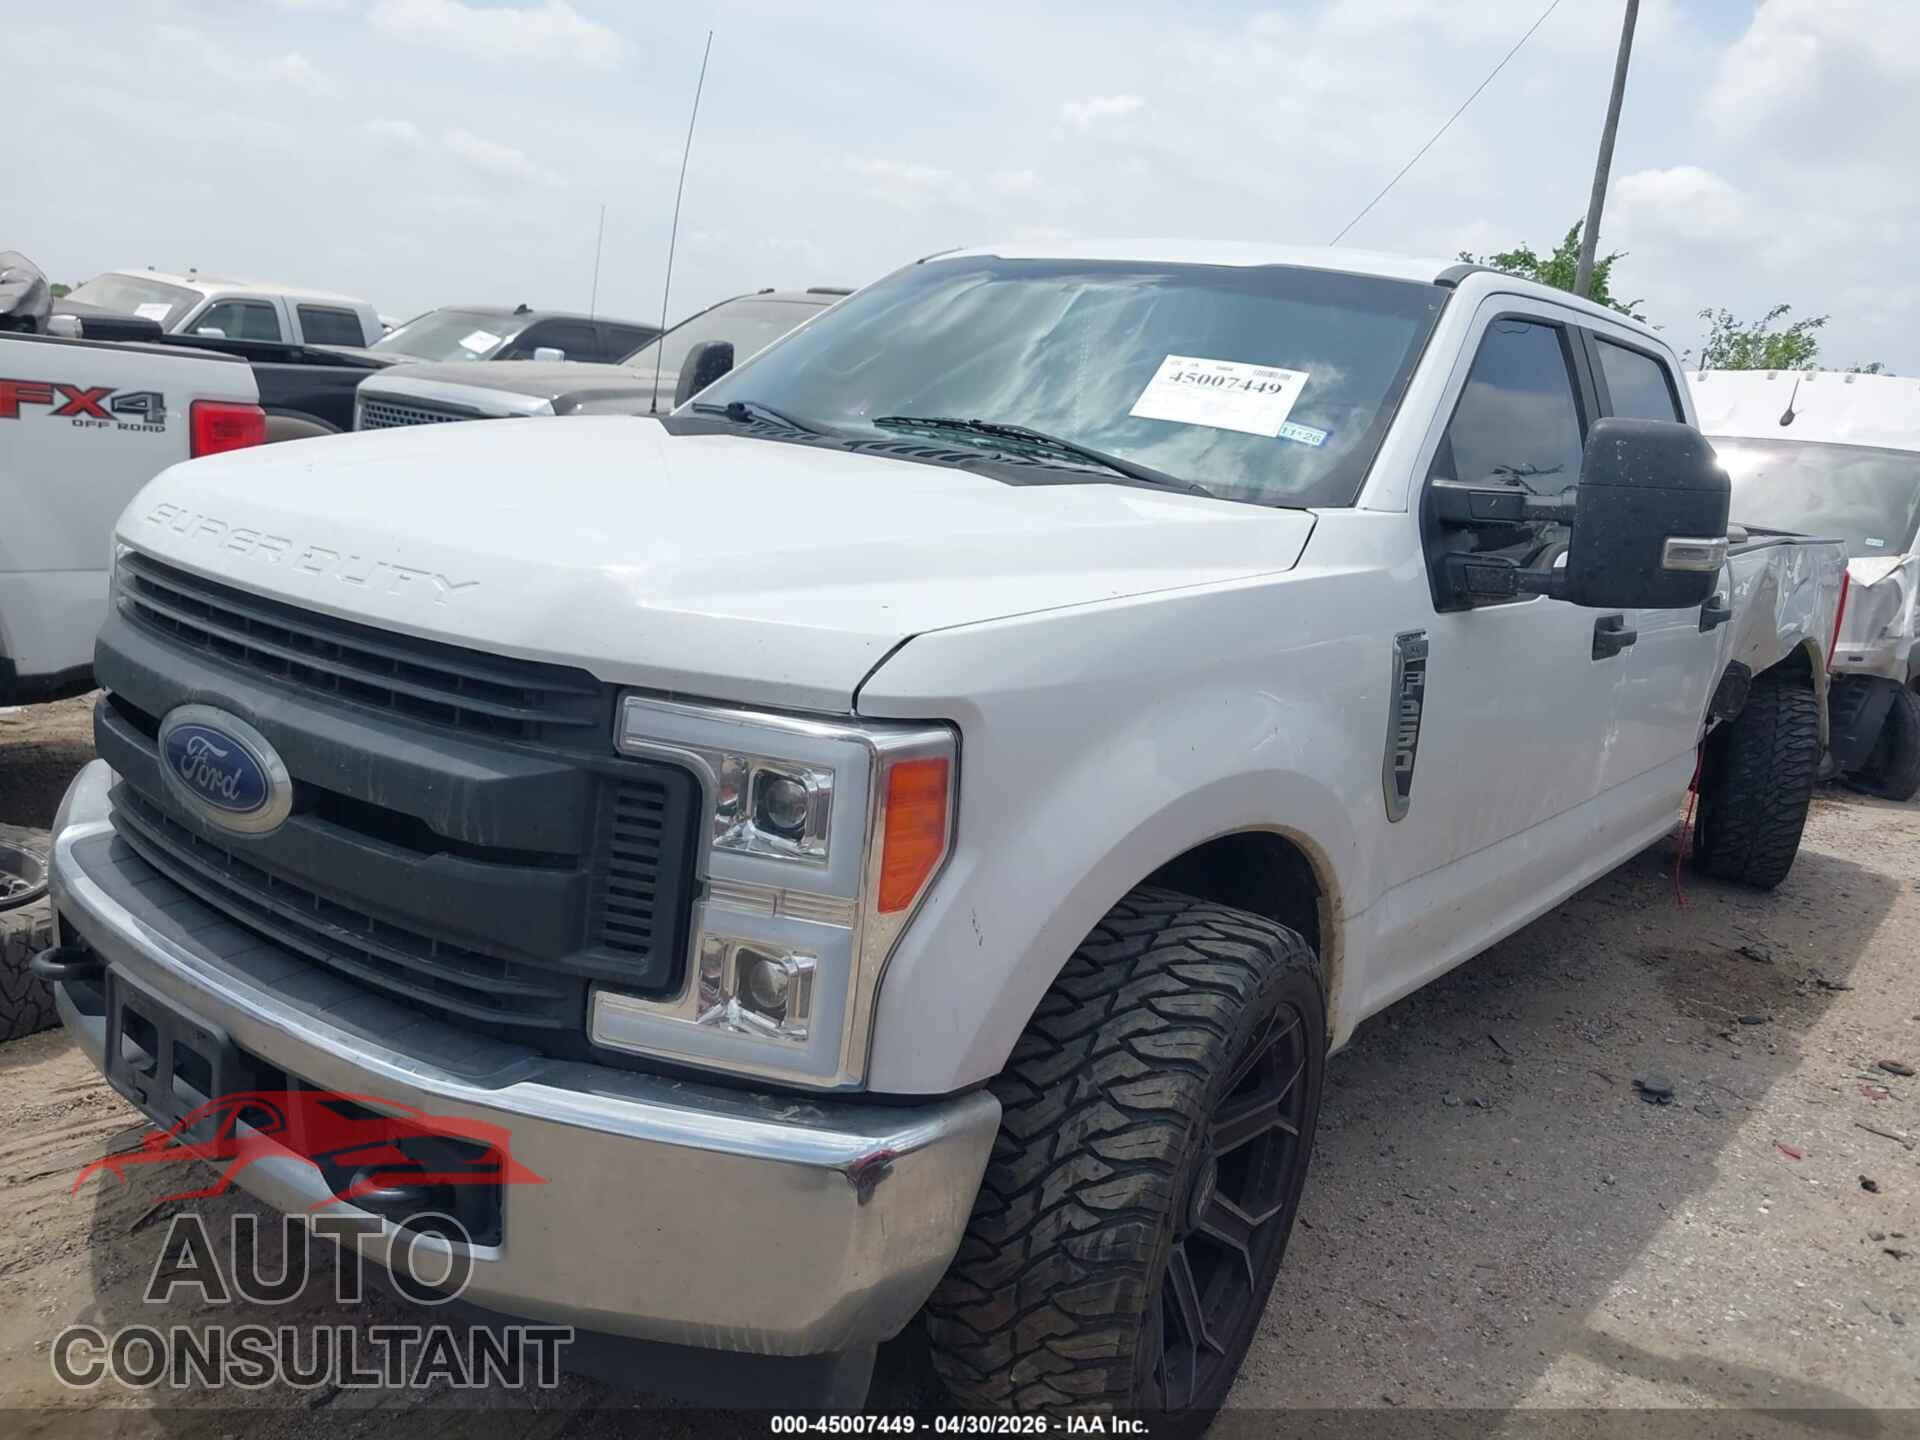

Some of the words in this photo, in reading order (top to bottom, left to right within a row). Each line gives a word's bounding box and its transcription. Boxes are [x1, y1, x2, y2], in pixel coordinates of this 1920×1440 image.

[0, 378, 167, 425] FX4
[1169, 371, 1282, 394] 45007449
[71, 418, 110, 429] OFF
[117, 422, 166, 433] ROAD
[144, 502, 293, 565] SUPER
[293, 544, 480, 608] DUTY
[180, 735, 243, 800] Ford
